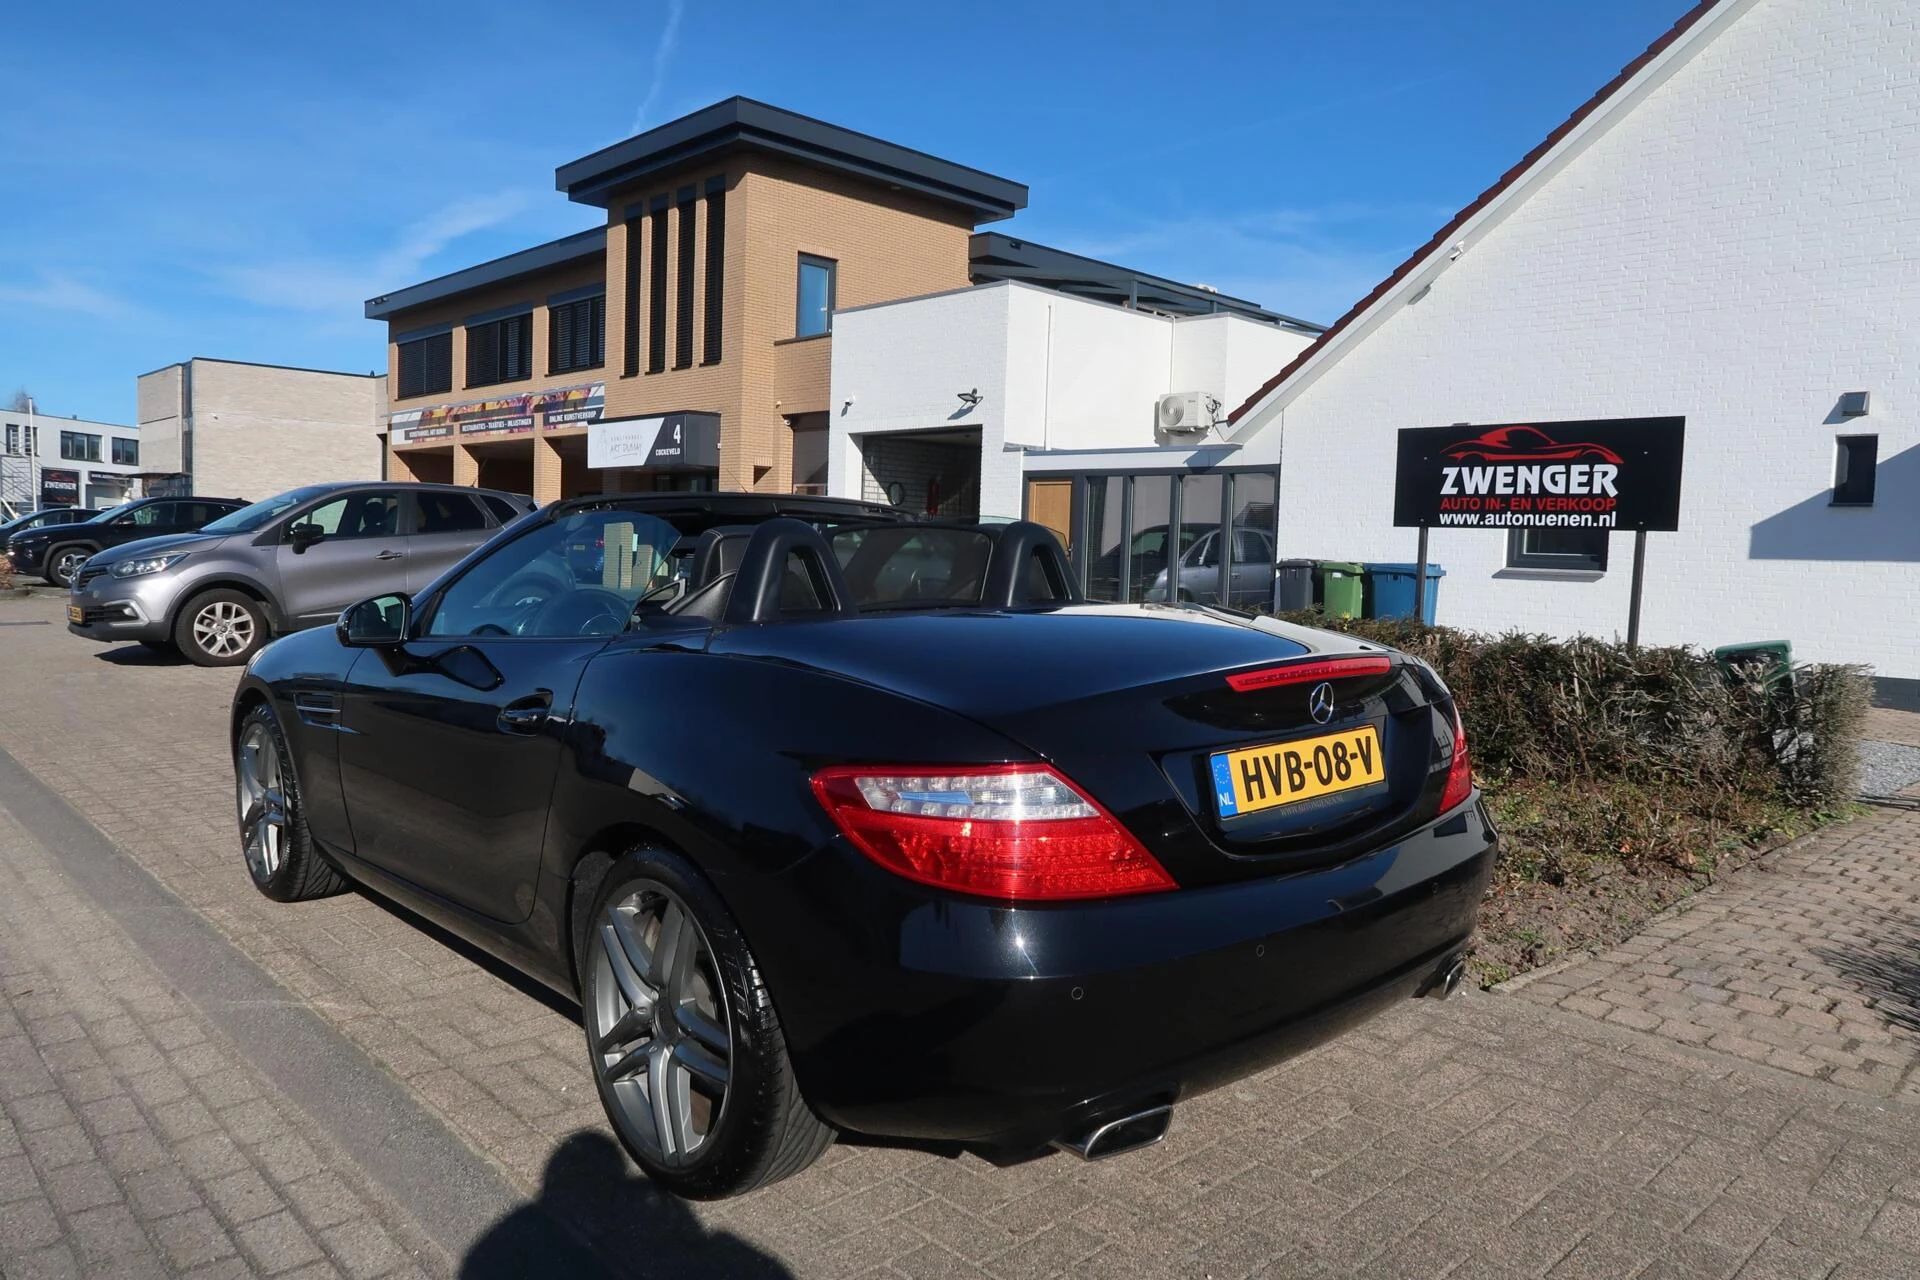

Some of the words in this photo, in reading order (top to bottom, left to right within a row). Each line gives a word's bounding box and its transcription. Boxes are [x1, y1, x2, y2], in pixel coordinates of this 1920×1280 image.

[673, 424, 681, 444] 4
[655, 447, 681, 456] COCKEVELD
[1440, 464, 1618, 498] ZWENGER
[1440, 498, 1480, 511] AUTO
[1485, 498, 1505, 511] IN-
[1512, 498, 1531, 511] EN
[1536, 497, 1617, 511] VERKOOP
[1439, 511, 1617, 527] www.autonuenen.nl
[1219, 793, 1234, 807] NL
[1240, 735, 1373, 803] HVB-08-V
